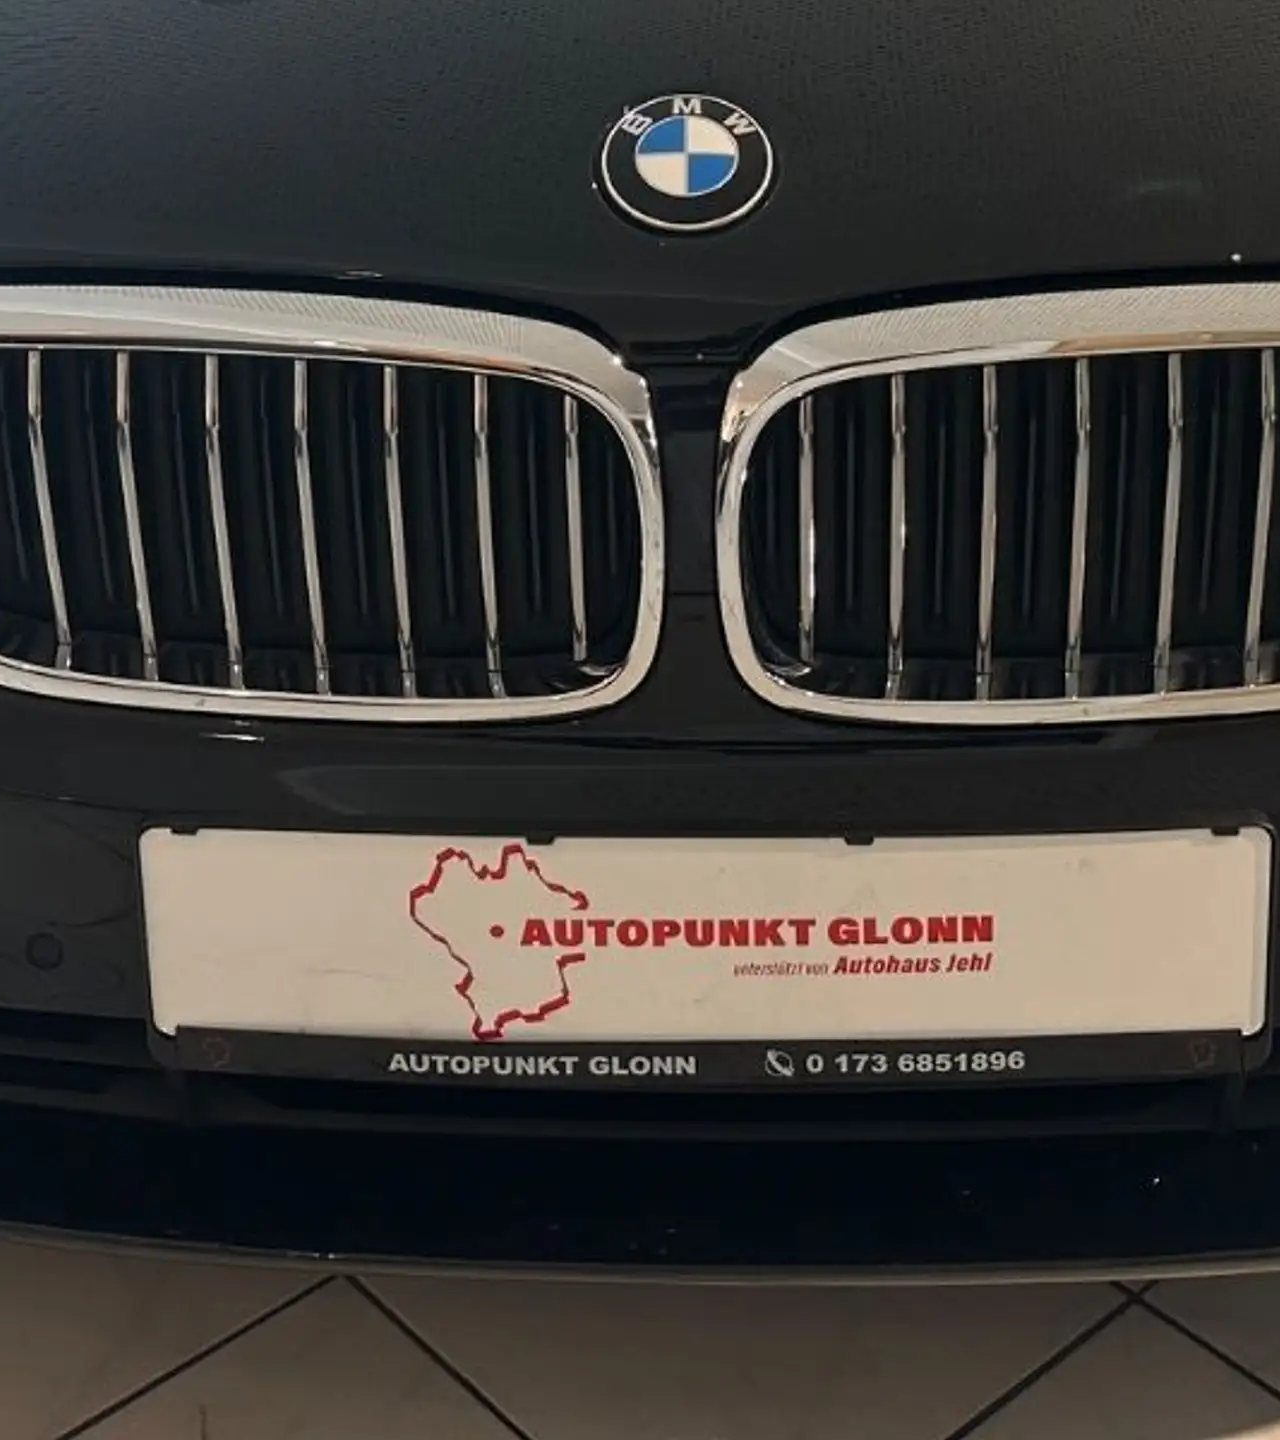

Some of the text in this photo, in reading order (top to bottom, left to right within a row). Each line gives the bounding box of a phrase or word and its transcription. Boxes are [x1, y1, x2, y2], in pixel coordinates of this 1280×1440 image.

[620, 96, 757, 137] BMW
[519, 915, 995, 948] AUTOPUNKT GLONN
[832, 954, 942, 975] Autohaus
[946, 951, 993, 973] Jehl
[388, 1053, 697, 1075] AUTOPUNKT GLONN
[805, 1051, 1026, 1073] 0 173 6851896
